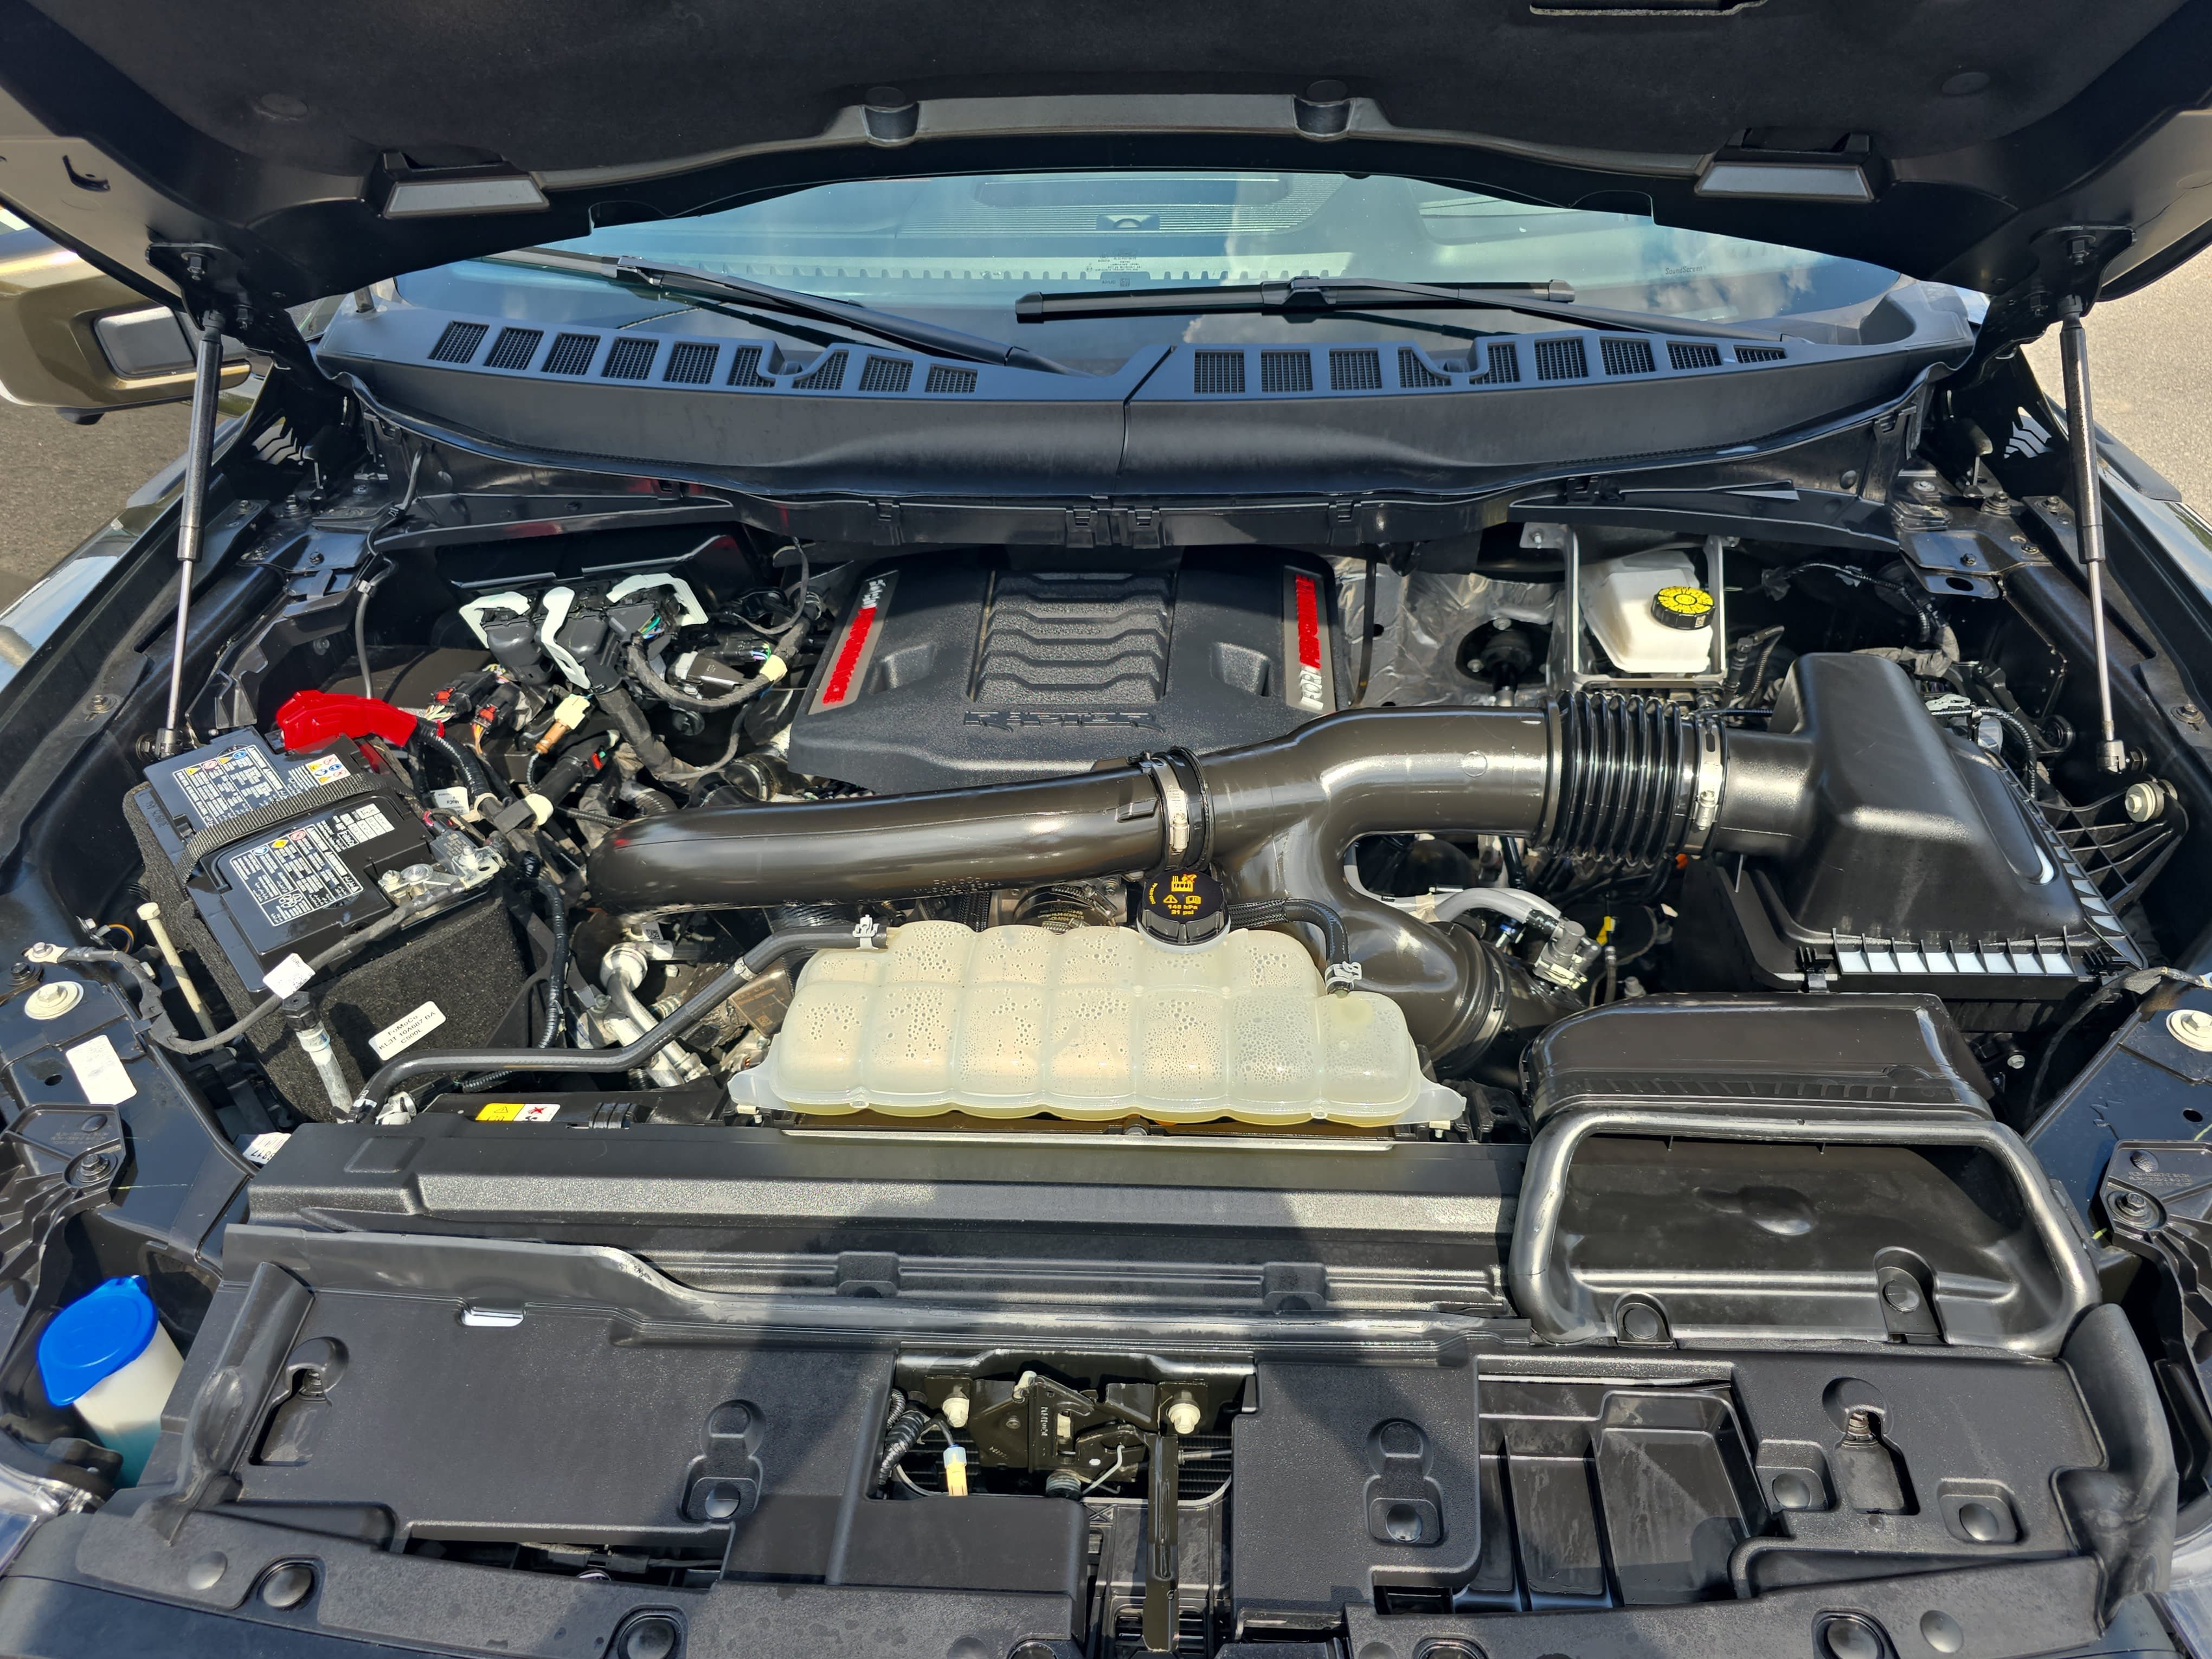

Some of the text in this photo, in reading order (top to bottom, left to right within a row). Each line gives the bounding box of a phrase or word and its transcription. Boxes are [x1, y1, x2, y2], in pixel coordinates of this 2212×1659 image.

[1300, 666, 1324, 710] FORD
[964, 711, 1165, 733] RAPTOR
[388, 1015, 418, 1036] FoMoCo
[378, 1036, 397, 1050] KL3T
